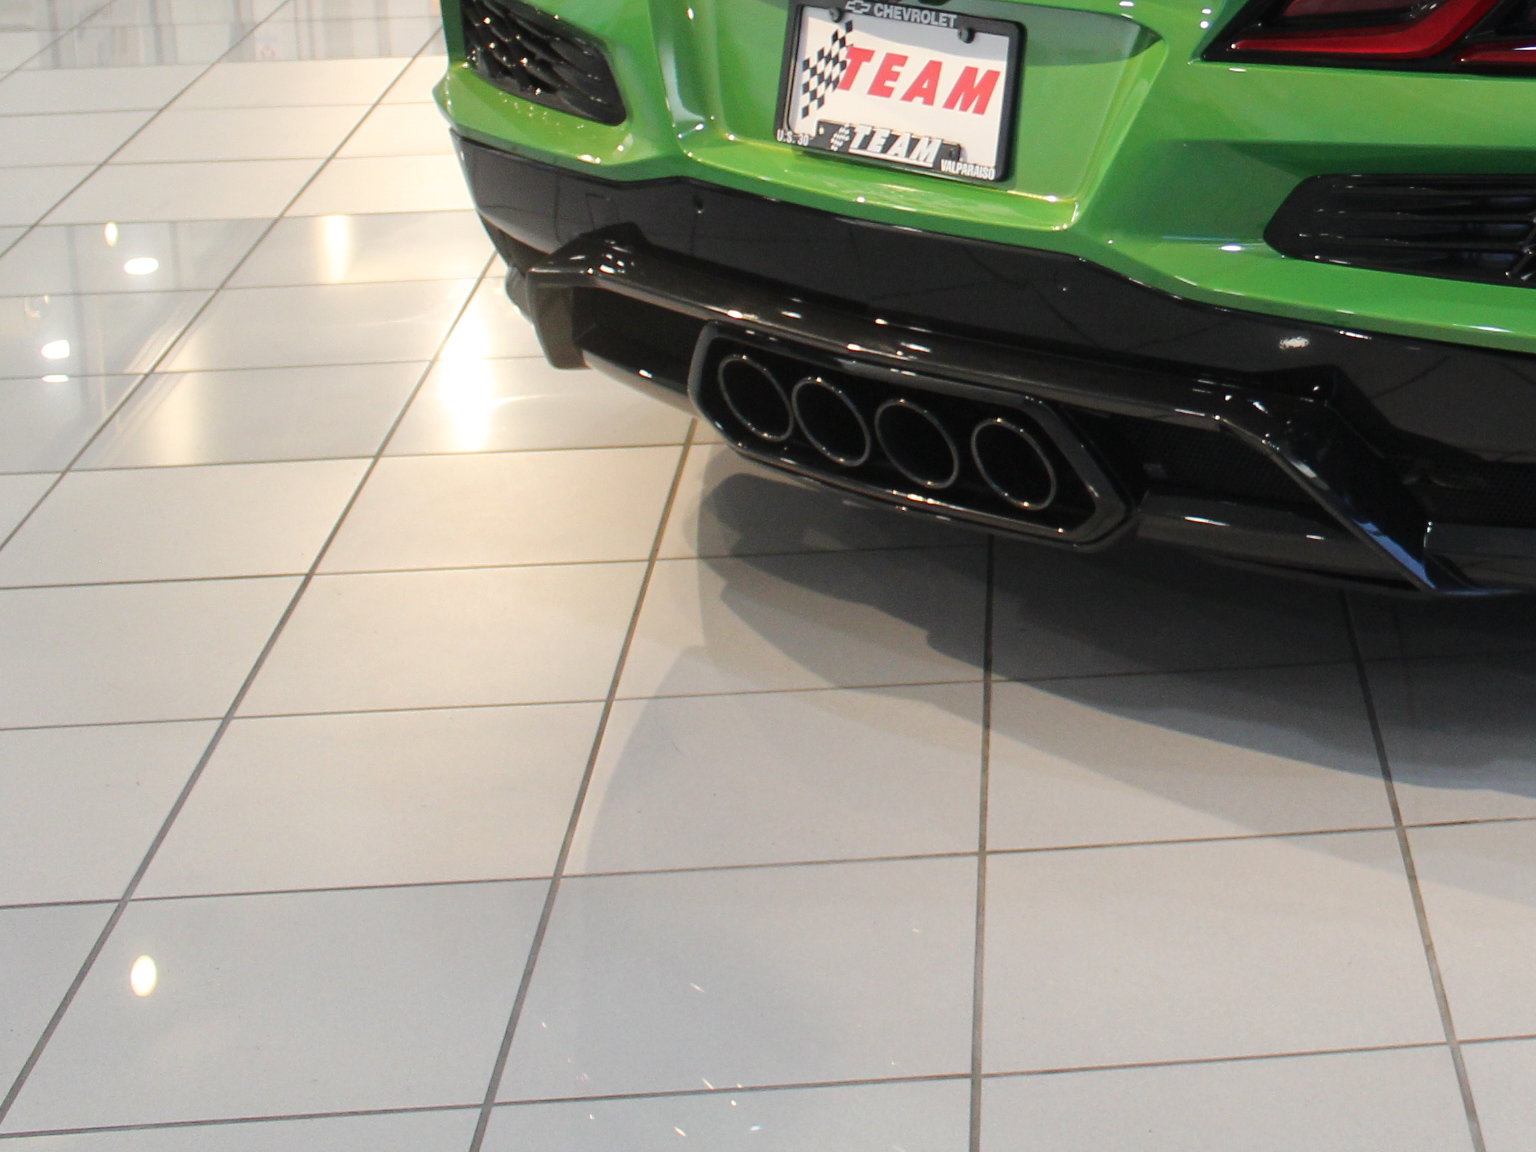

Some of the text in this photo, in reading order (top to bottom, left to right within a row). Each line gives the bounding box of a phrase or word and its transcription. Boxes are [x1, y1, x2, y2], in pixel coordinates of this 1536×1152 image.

[873, 4, 957, 29] CHEVROLET
[837, 45, 1001, 116] TEAM
[798, 134, 809, 147] 30
[849, 124, 942, 165] TEAM
[941, 159, 996, 181] VALPARAISO
